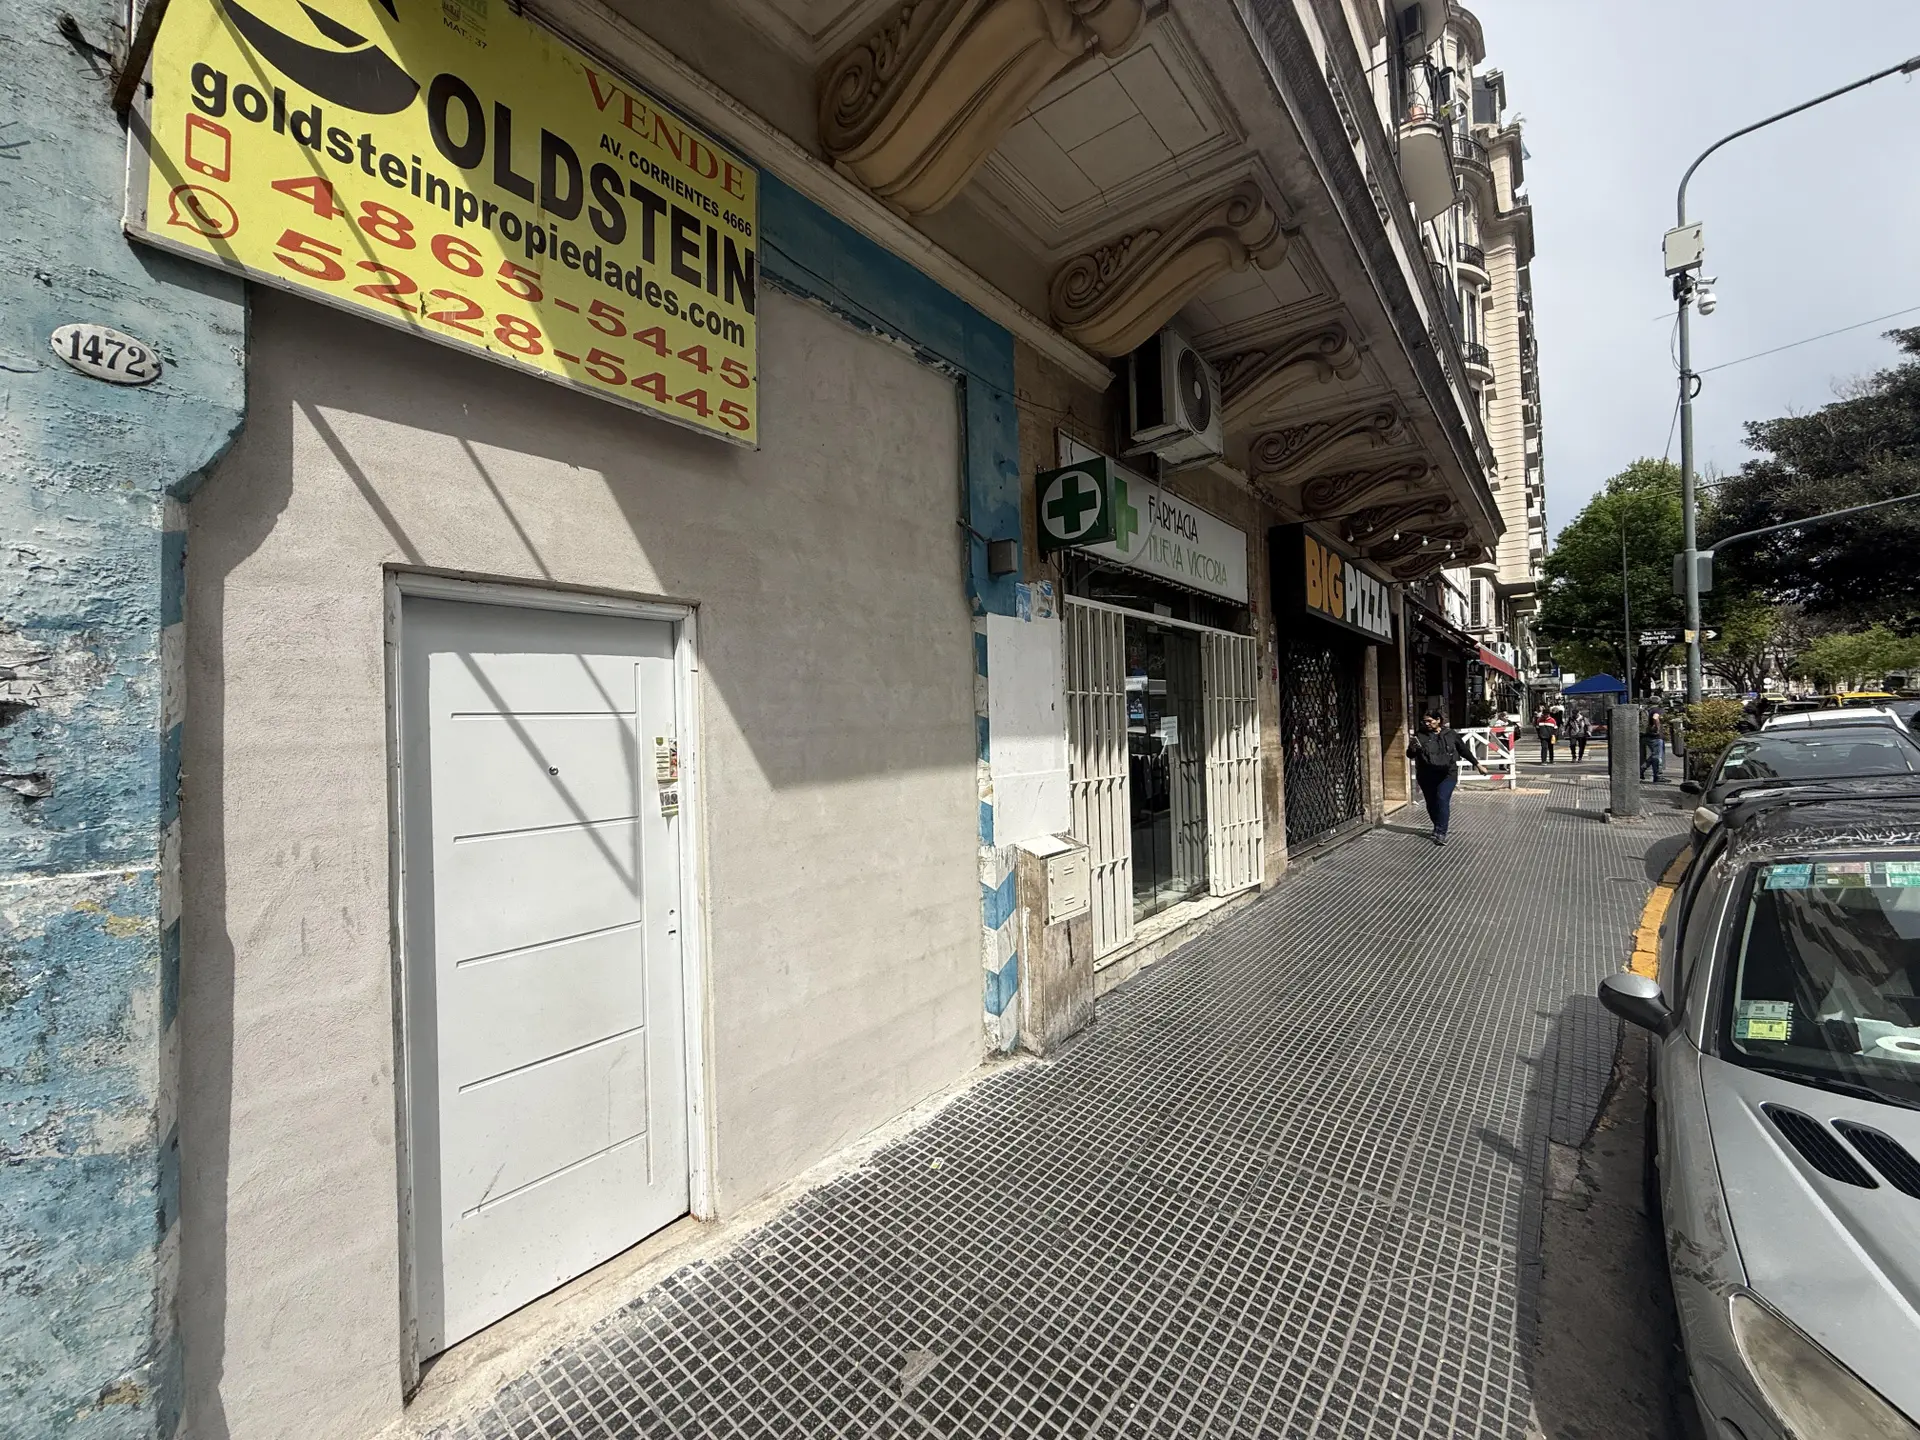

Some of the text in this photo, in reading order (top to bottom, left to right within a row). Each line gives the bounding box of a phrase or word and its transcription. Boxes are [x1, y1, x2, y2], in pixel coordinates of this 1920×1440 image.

[475, 37, 488, 49] 37
[580, 63, 746, 202] VENDE
[599, 133, 752, 237] AV. CORRIENTES 4666
[190, 62, 746, 348] goldsteinpropiedades.com
[271, 175, 751, 391] 4865-5445
[272, 228, 752, 433] 5228-5445
[68, 329, 147, 378] 1472
[1148, 494, 1199, 544] FARMACIA
[1148, 534, 1229, 588] NUEVA VICTORIA
[1305, 534, 1393, 640] BIG PIZZA
